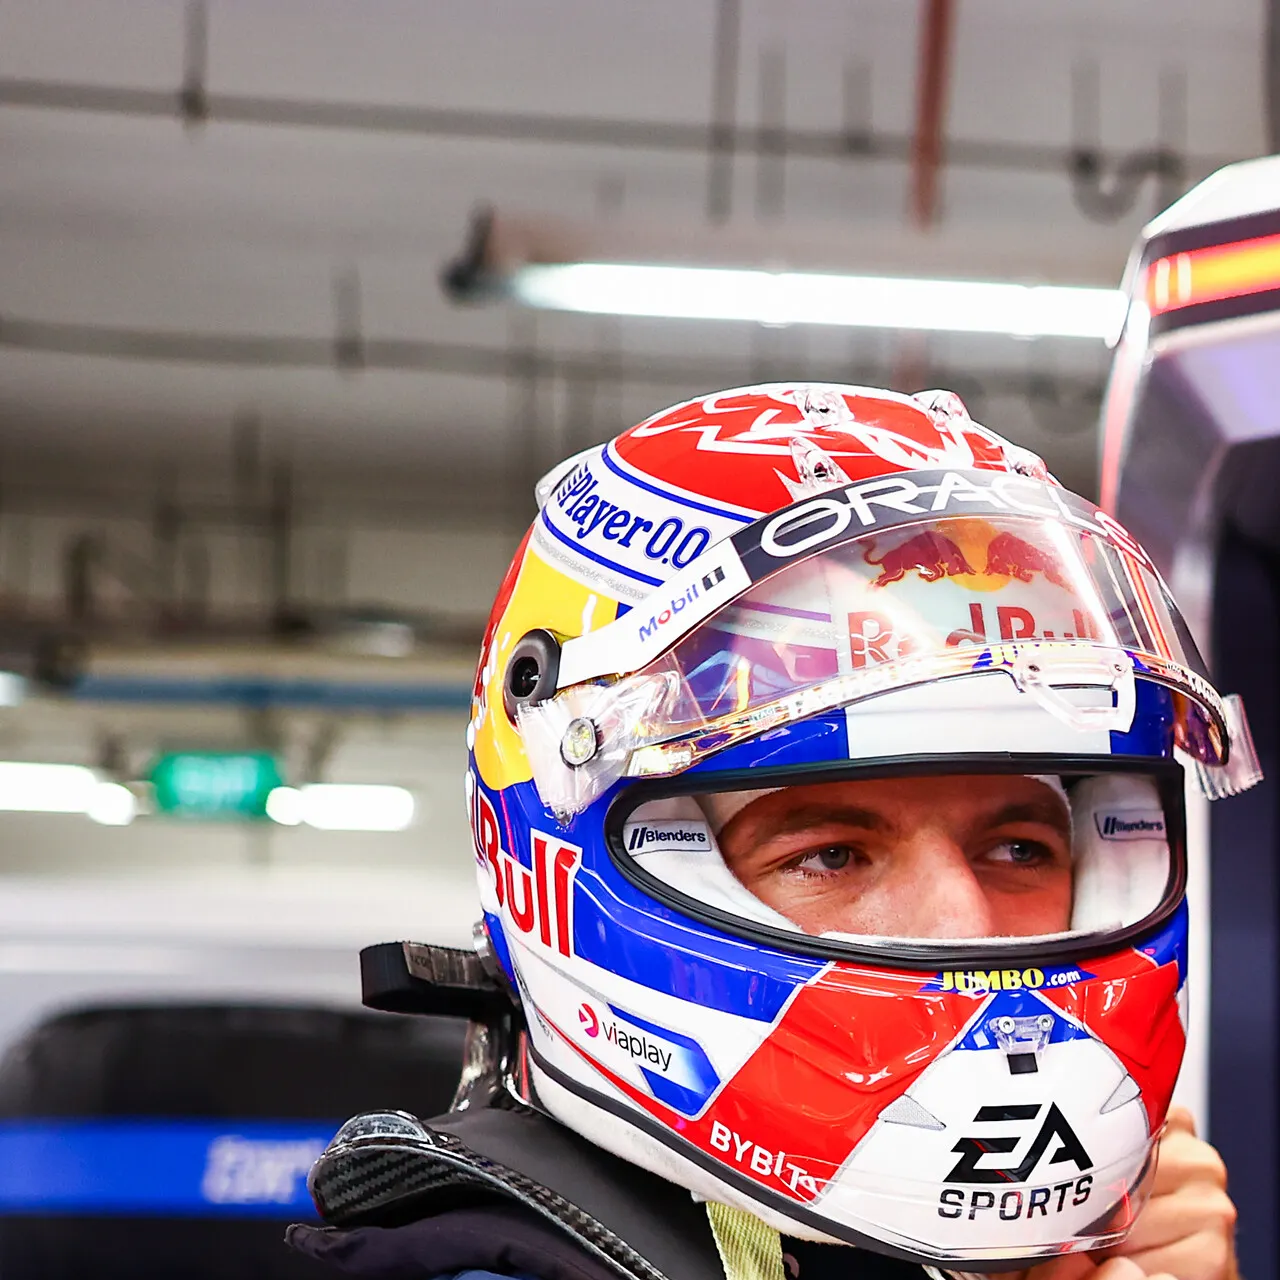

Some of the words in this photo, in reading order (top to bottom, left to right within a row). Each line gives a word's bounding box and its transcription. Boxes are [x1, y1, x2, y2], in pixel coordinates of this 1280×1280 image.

[559, 471, 653, 548] Player
[645, 516, 711, 570] 0.0
[638, 584, 700, 642] Mobil
[602, 1021, 673, 1072] viaplay
[943, 1101, 1094, 1184] EA
[938, 1176, 1094, 1221] SPORTS
